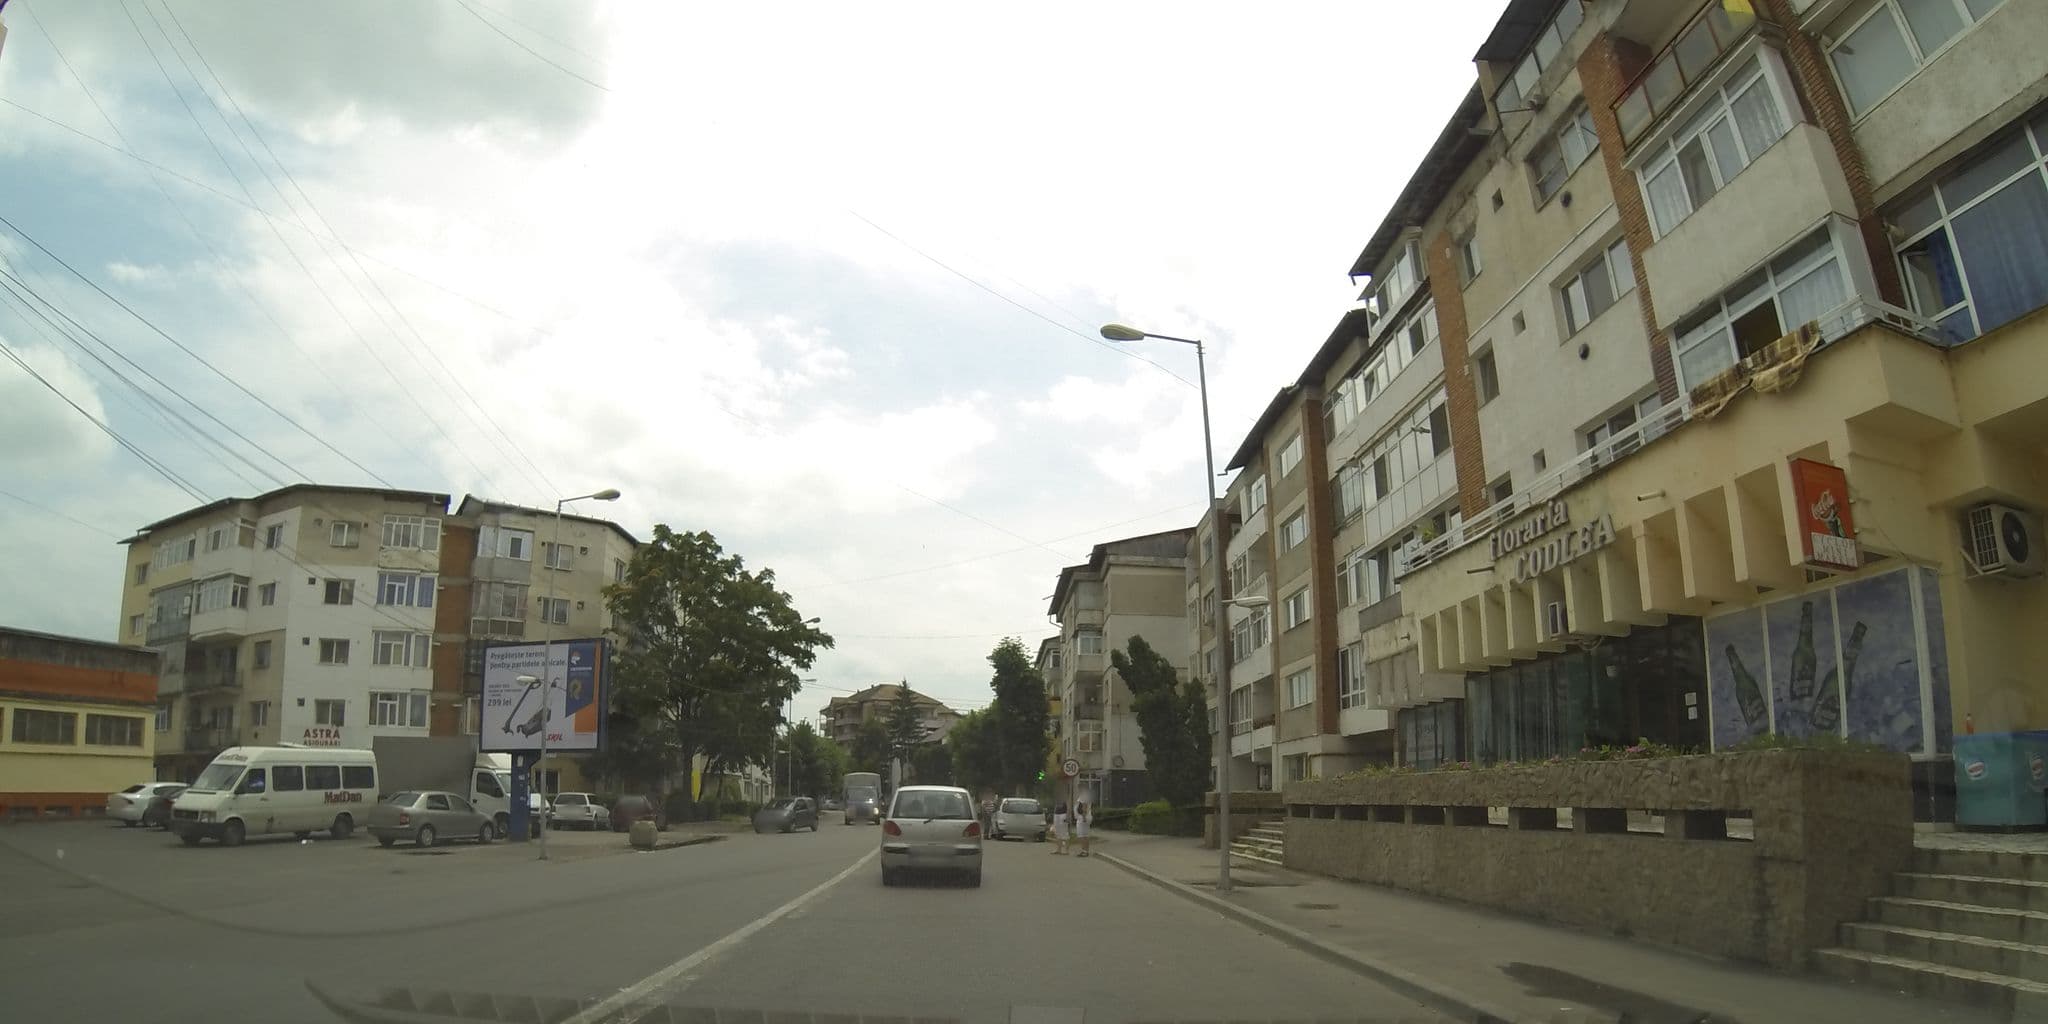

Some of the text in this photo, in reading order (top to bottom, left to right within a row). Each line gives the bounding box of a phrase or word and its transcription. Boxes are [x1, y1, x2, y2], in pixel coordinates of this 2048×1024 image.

[1489, 498, 1569, 561] floraria
[1514, 512, 1616, 585] CODLEA
[303, 728, 341, 739] ASTRA
[1066, 763, 1077, 772] 50
